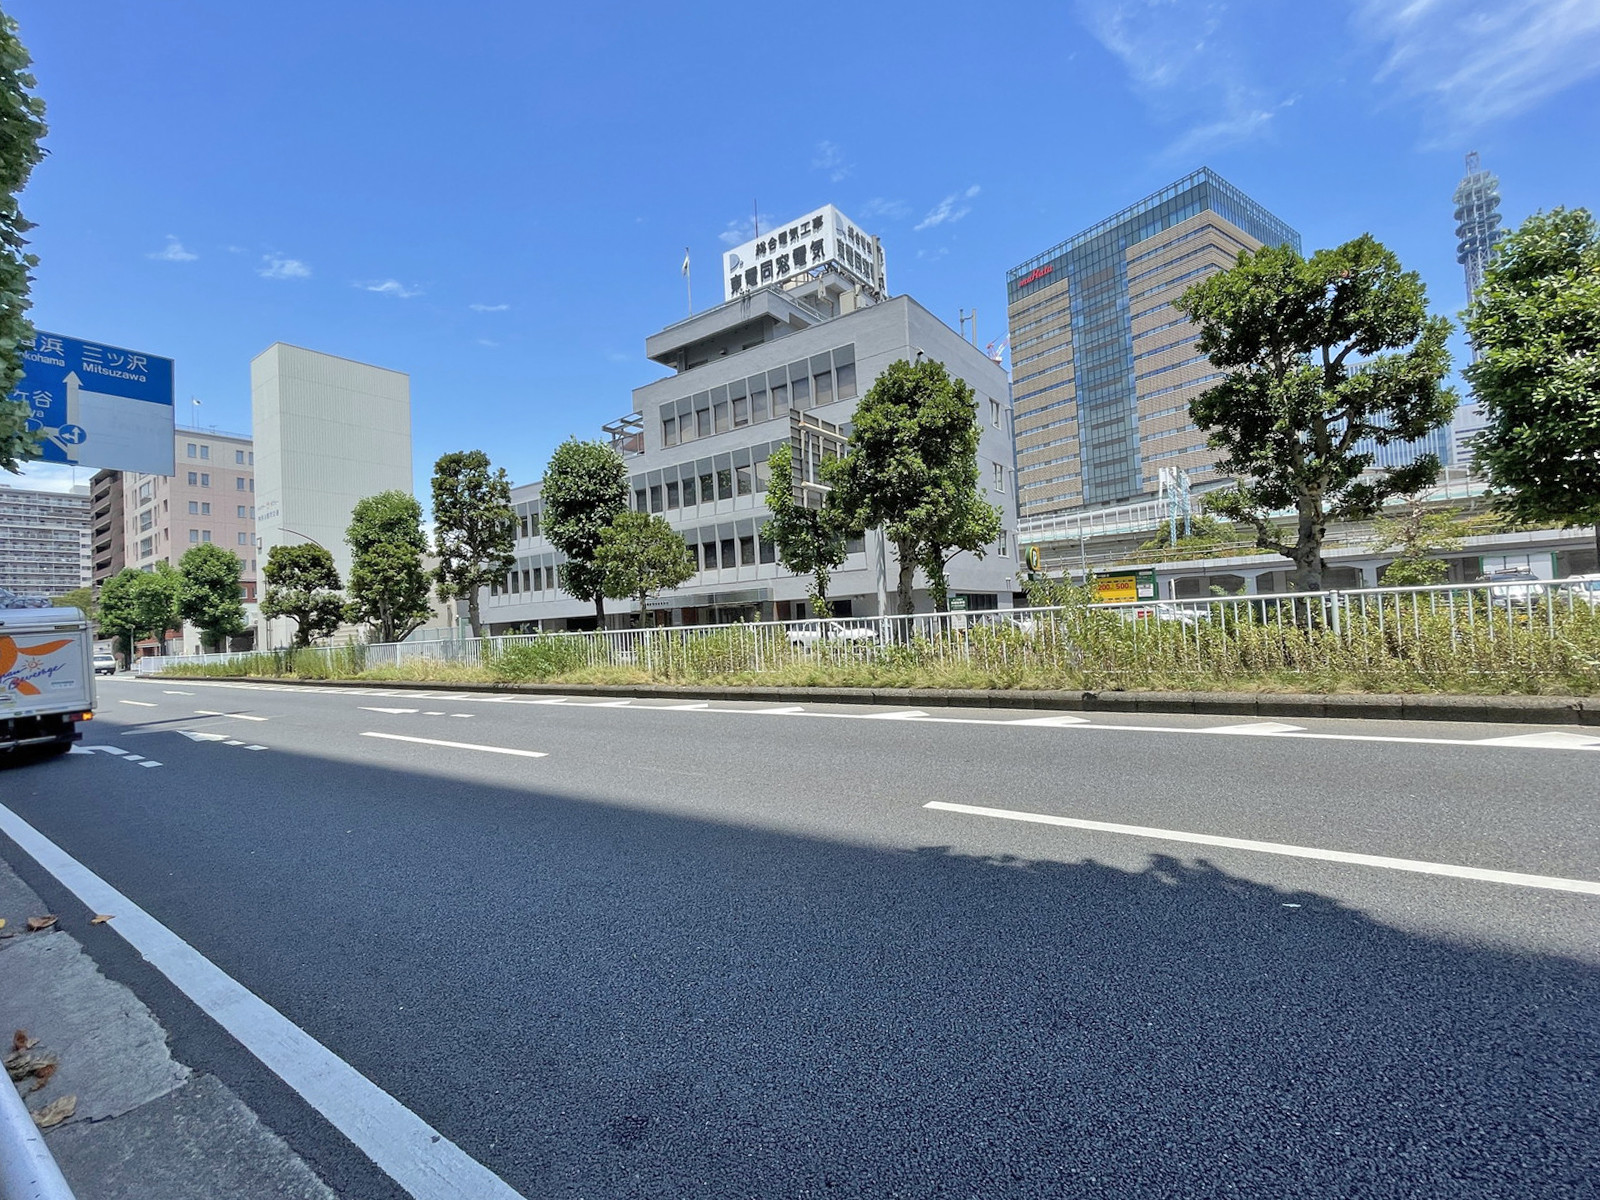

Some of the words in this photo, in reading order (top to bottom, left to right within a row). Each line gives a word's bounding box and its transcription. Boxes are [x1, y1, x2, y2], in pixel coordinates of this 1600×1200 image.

[81, 345, 148, 372] 三ツ沢
[83, 362, 147, 382] Mitsuzawa
[3, 663, 66, 690] Beverage
